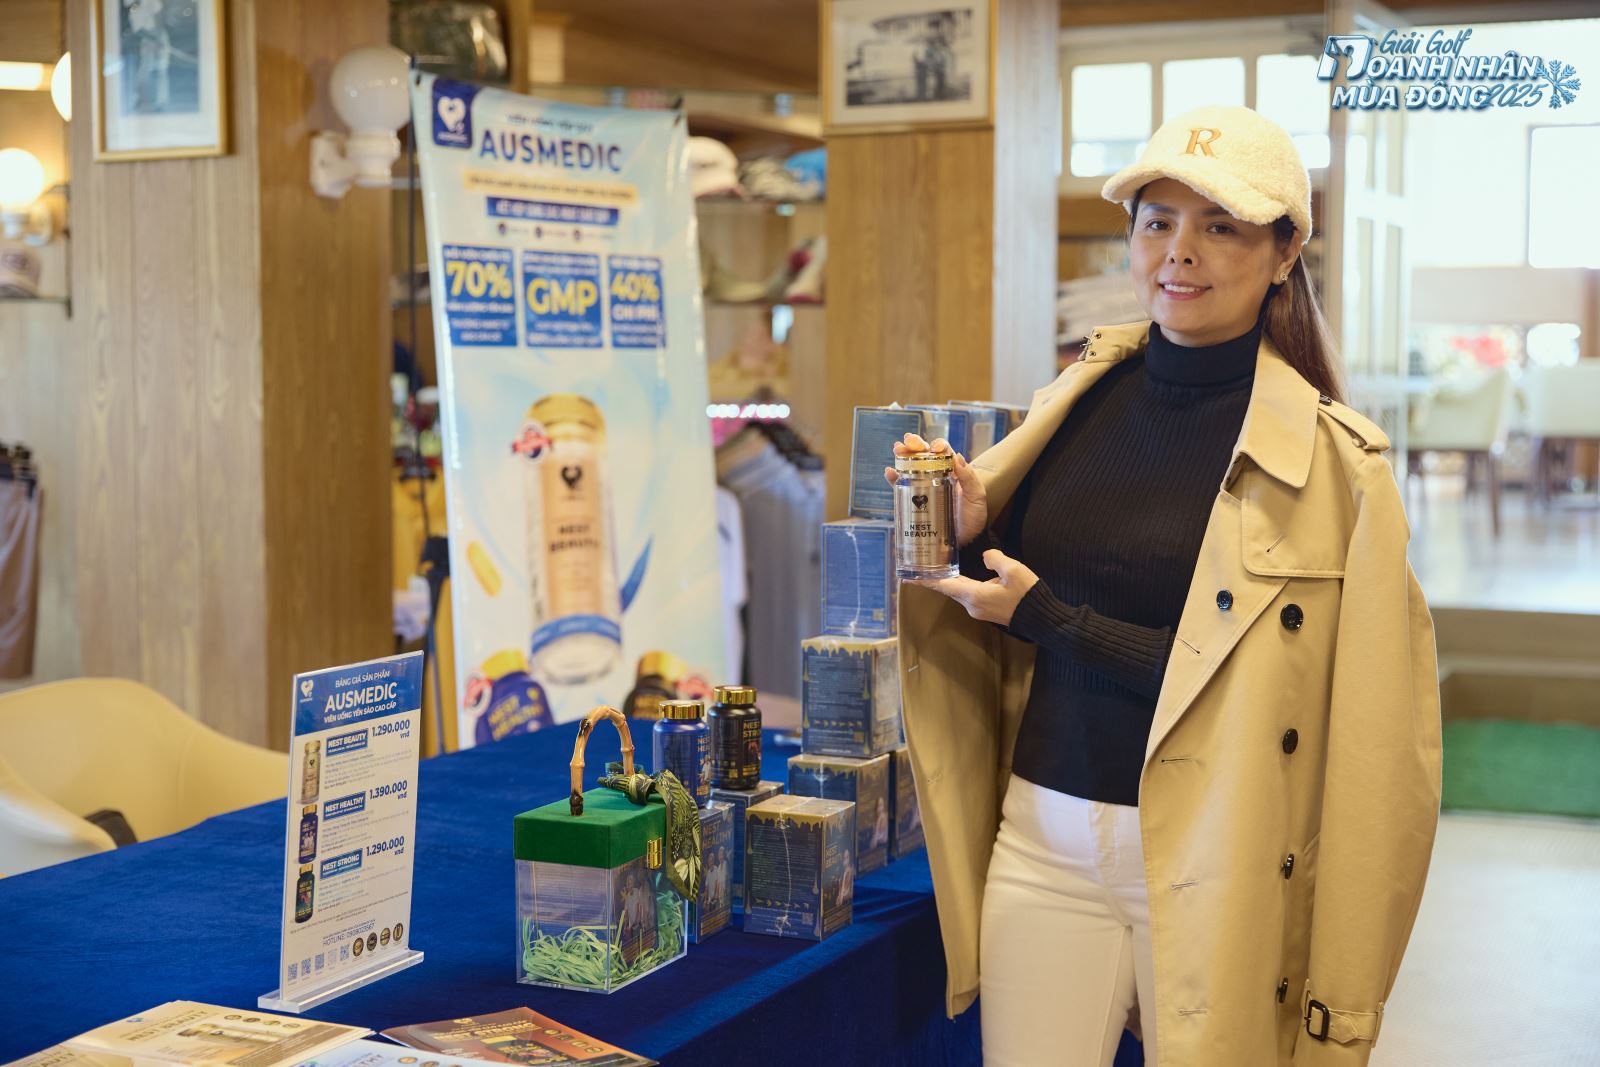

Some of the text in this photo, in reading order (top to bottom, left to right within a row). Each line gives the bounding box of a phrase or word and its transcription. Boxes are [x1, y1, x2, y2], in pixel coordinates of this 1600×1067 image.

[479, 129, 622, 172] AUSMEDIC
[1181, 127, 1222, 159] R
[446, 261, 512, 299] 70%
[611, 271, 660, 302] 40%
[527, 277, 597, 315] GMP
[904, 530, 938, 538] BEAUTY
[324, 682, 398, 713] AUSMEDIC
[374, 703, 386, 713] CAO
[372, 719, 411, 737] 1.290.000
[327, 737, 344, 749] NEST
[343, 732, 367, 745] BEAUTY
[369, 780, 408, 799] 1.390.000
[325, 802, 340, 813] NEST
[339, 796, 364, 809] HEALTHY
[366, 836, 405, 856] 1.290.000
[322, 860, 338, 872] NEST
[337, 853, 360, 867] STRONG
